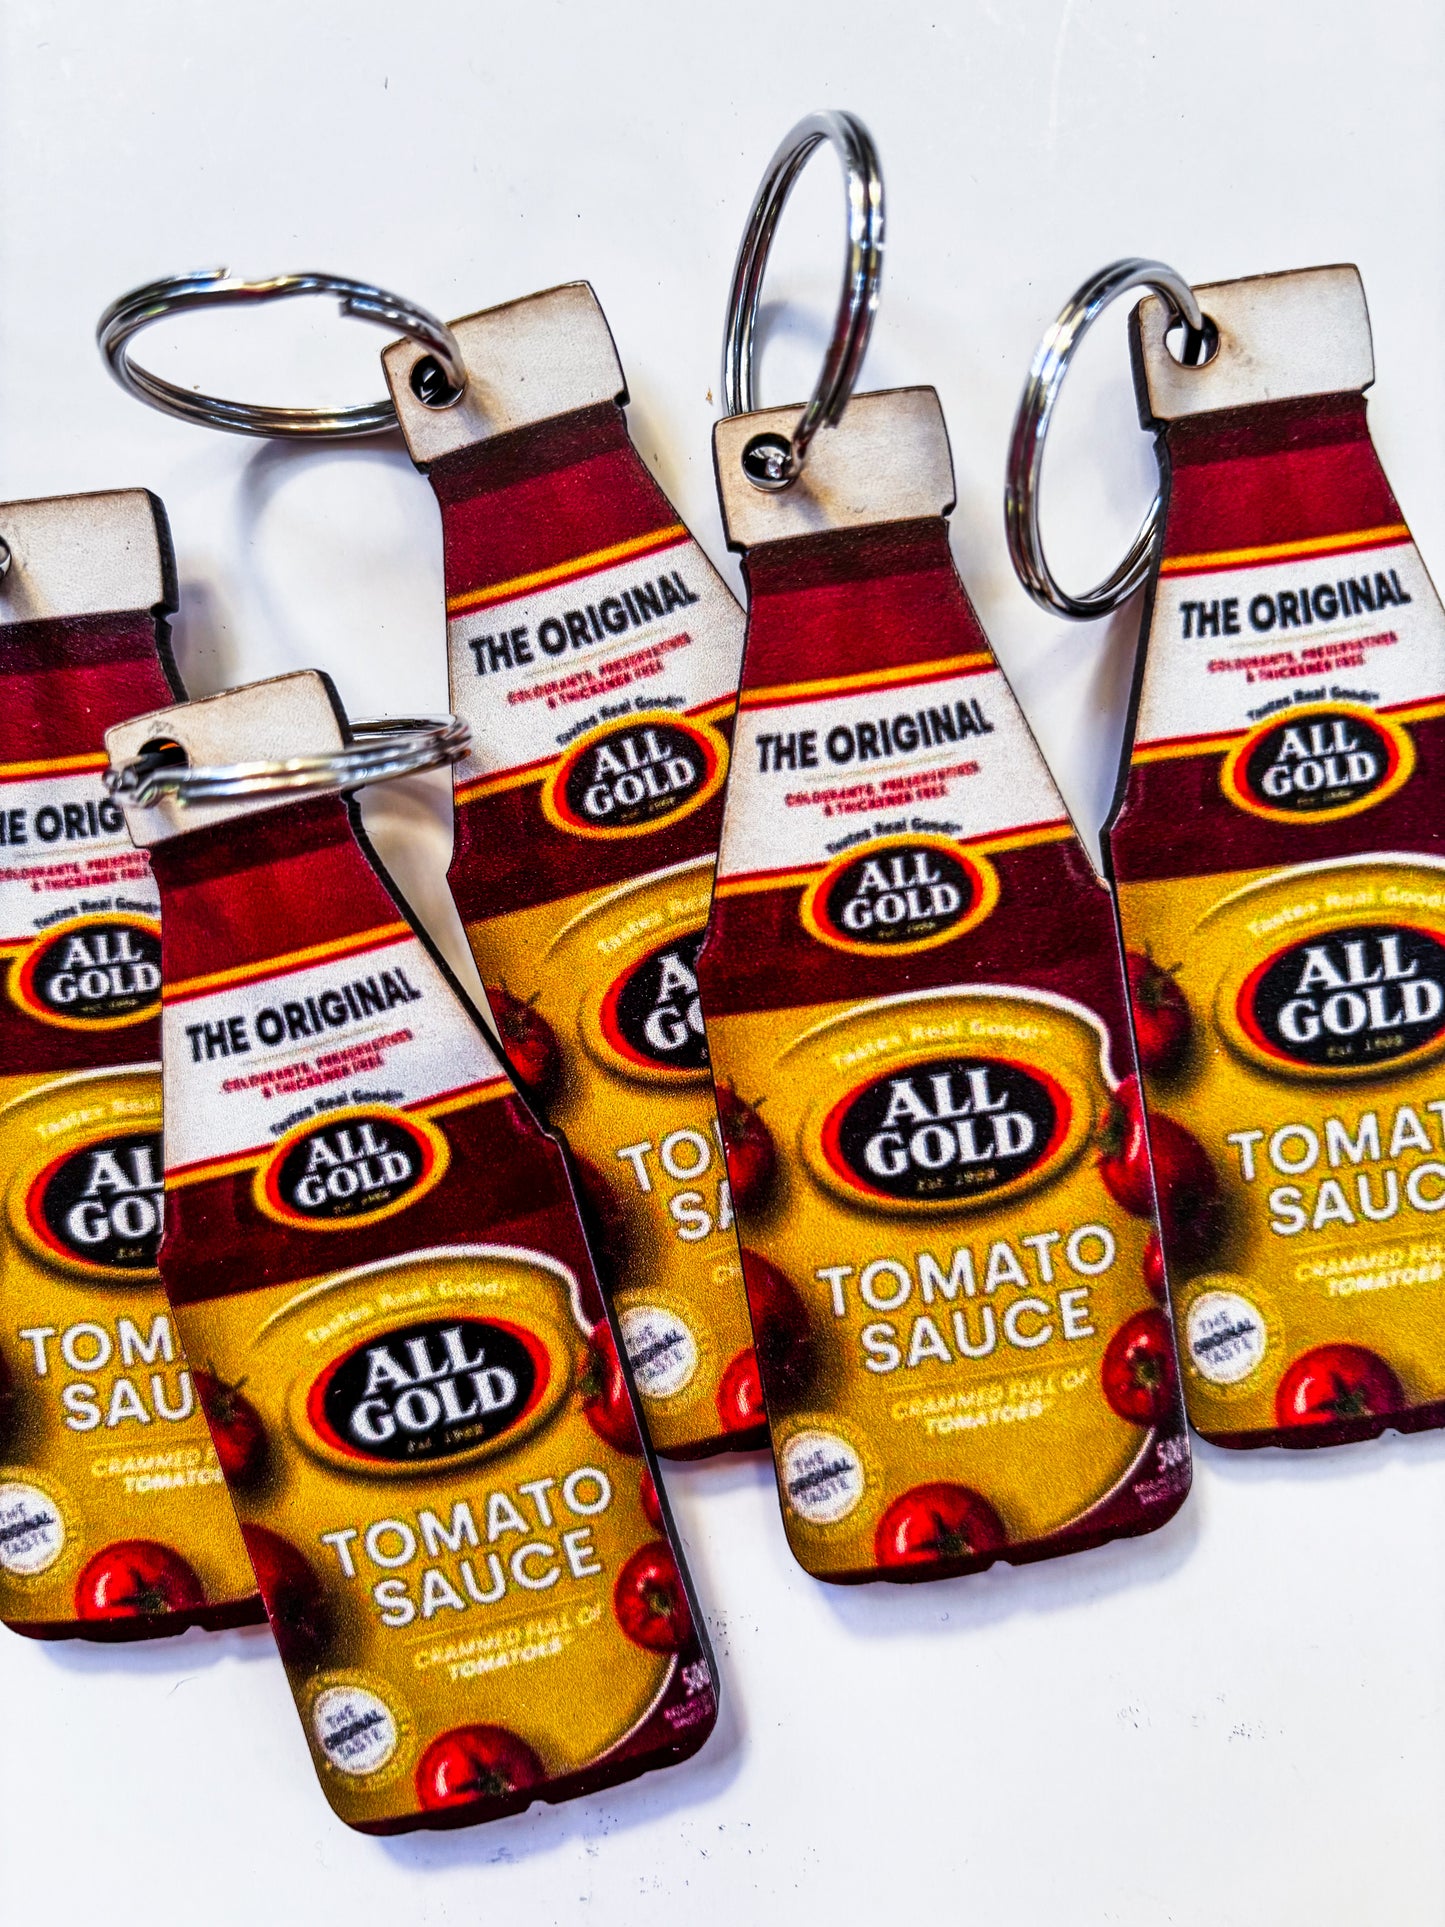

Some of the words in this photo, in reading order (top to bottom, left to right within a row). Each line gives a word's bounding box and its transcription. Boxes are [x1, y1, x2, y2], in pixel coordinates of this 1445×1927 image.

[468, 626, 535, 675] THE
[537, 571, 699, 656] ORIGINAL
[1180, 597, 1241, 639] THE
[1248, 568, 1412, 632] ORIGINAL
[594, 730, 672, 781] ALL
[755, 730, 818, 773] THE
[825, 698, 994, 765] ORIGINAL
[1275, 720, 1360, 764] ALL
[583, 756, 696, 816] GOLD
[1261, 752, 1377, 797] GOLD
[857, 852, 942, 895] ALL
[842, 882, 961, 930] GOLD
[60, 931, 143, 970] ALL
[1296, 934, 1420, 995] ALL
[48, 962, 162, 1004] GOLD
[1277, 979, 1444, 1043] GOLD
[186, 1015, 251, 1063] THE
[255, 966, 423, 1047] ORIGINAL
[881, 1068, 1008, 1127] ALL
[304, 1123, 390, 1172] ALL
[864, 1110, 1036, 1177] GOLD
[293, 1151, 413, 1208] GOLD
[1268, 1162, 1445, 1236] SAUC
[67, 1190, 165, 1245] GO
[815, 1225, 1115, 1316] TOMATO
[20, 1315, 187, 1376] TOM
[861, 1287, 1095, 1373] SAUCE
[362, 1325, 485, 1399] ALL
[62, 1371, 196, 1432] SAU
[350, 1366, 518, 1446] GOLD
[321, 1467, 612, 1578] TOMATO
[372, 1527, 603, 1628] SAUCE
